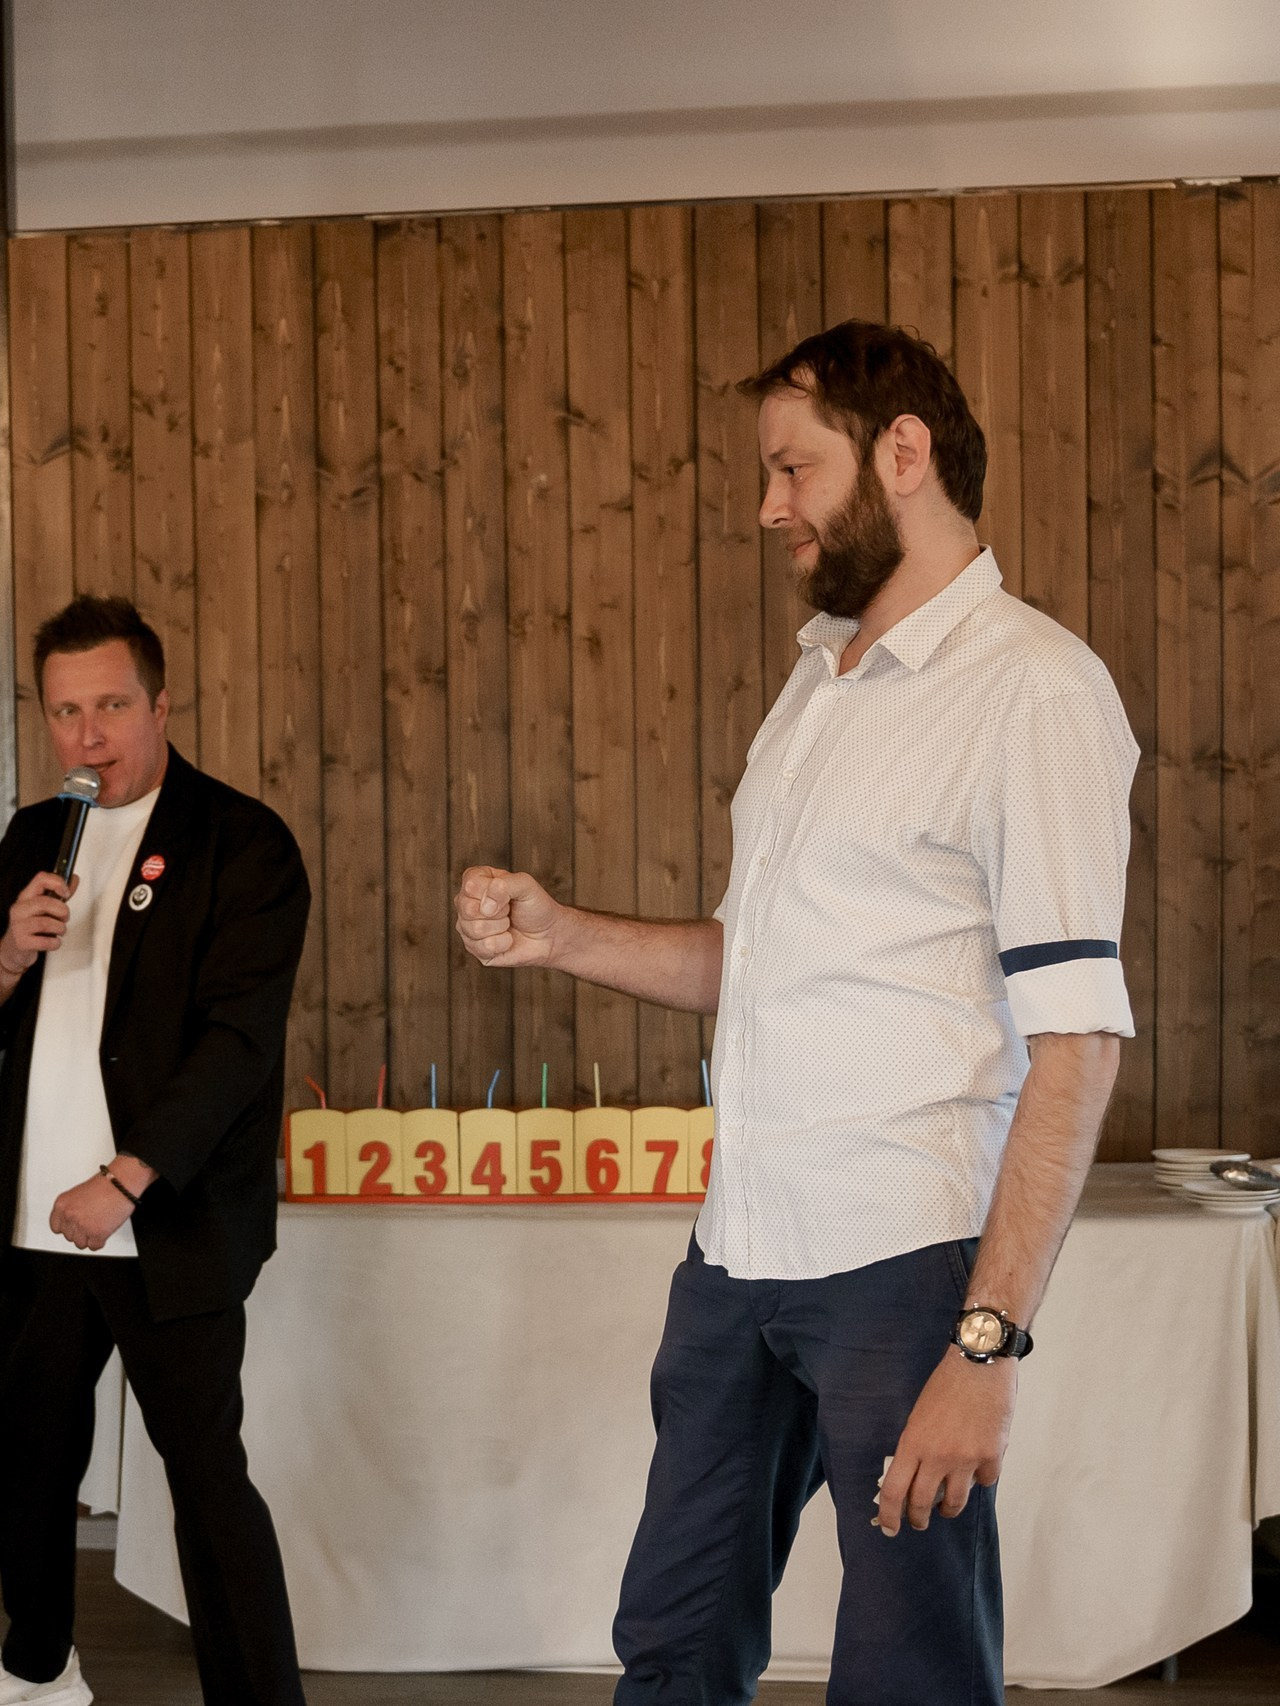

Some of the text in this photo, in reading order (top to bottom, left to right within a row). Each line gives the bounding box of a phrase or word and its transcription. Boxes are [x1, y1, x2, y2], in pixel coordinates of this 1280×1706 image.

[303, 1140, 328, 1194] 1
[358, 1140, 393, 1194] 2
[414, 1140, 448, 1194] 3
[471, 1141, 506, 1194] 4
[530, 1140, 563, 1194] 5
[584, 1139, 620, 1194] 6
[644, 1139, 679, 1194] 7
